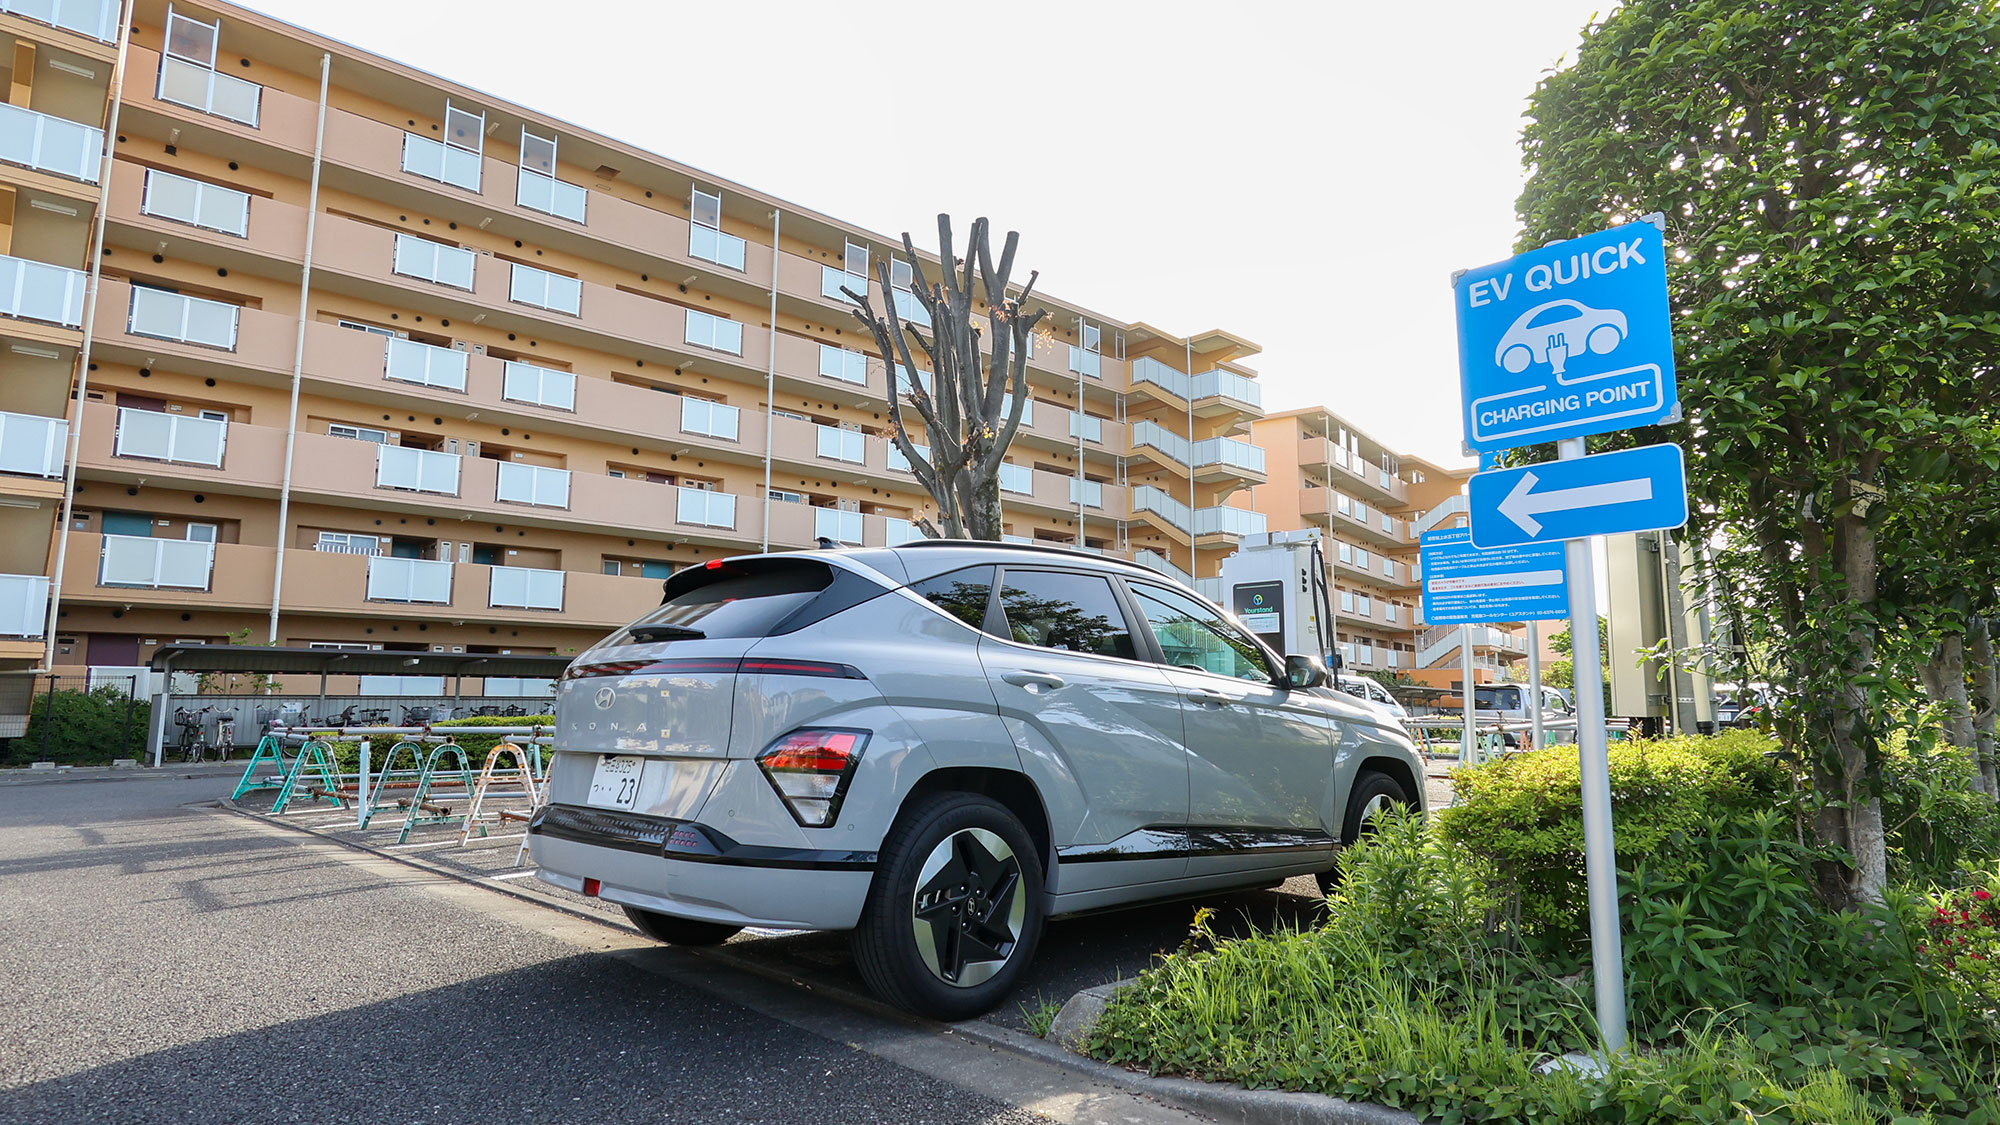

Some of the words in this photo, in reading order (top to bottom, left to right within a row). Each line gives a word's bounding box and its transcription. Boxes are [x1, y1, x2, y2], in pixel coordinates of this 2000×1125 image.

[1469, 272, 1513, 308] EV
[1524, 237, 1646, 292] QUICK
[1480, 395, 1580, 427] CHARGING
[1586, 381, 1650, 407] POINT
